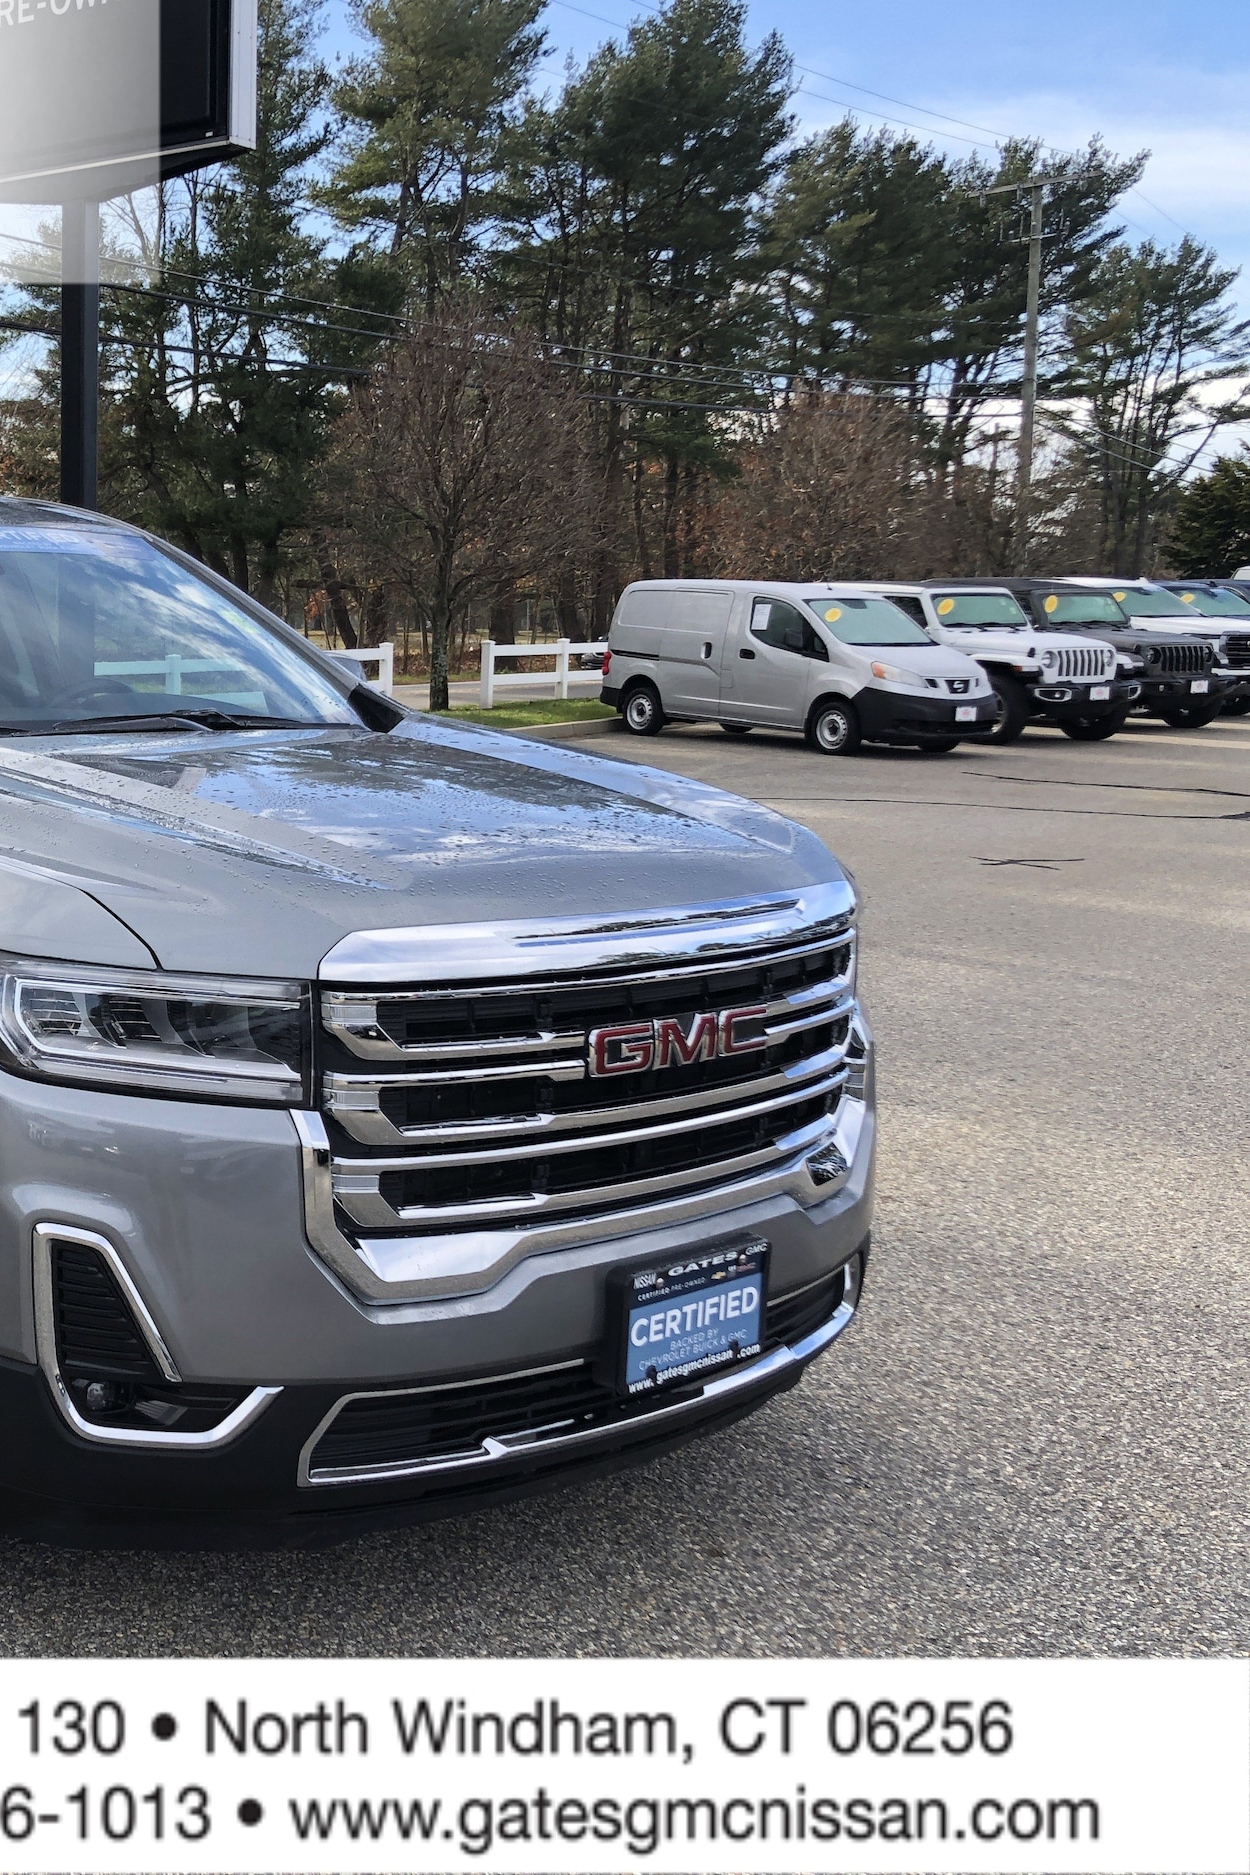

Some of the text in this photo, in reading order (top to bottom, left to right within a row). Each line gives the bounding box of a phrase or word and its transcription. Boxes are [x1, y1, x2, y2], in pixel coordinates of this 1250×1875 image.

[588, 1003, 769, 1078] GMC
[632, 1242, 768, 1289] NISSAN GATES GMC
[630, 1286, 759, 1348] CERTIFIED
[669, 1328, 719, 1351] BACKED BY
[638, 1345, 692, 1371] CHEVROLET
[692, 1339, 719, 1355] BUICK
[727, 1329, 749, 1345] GMC
